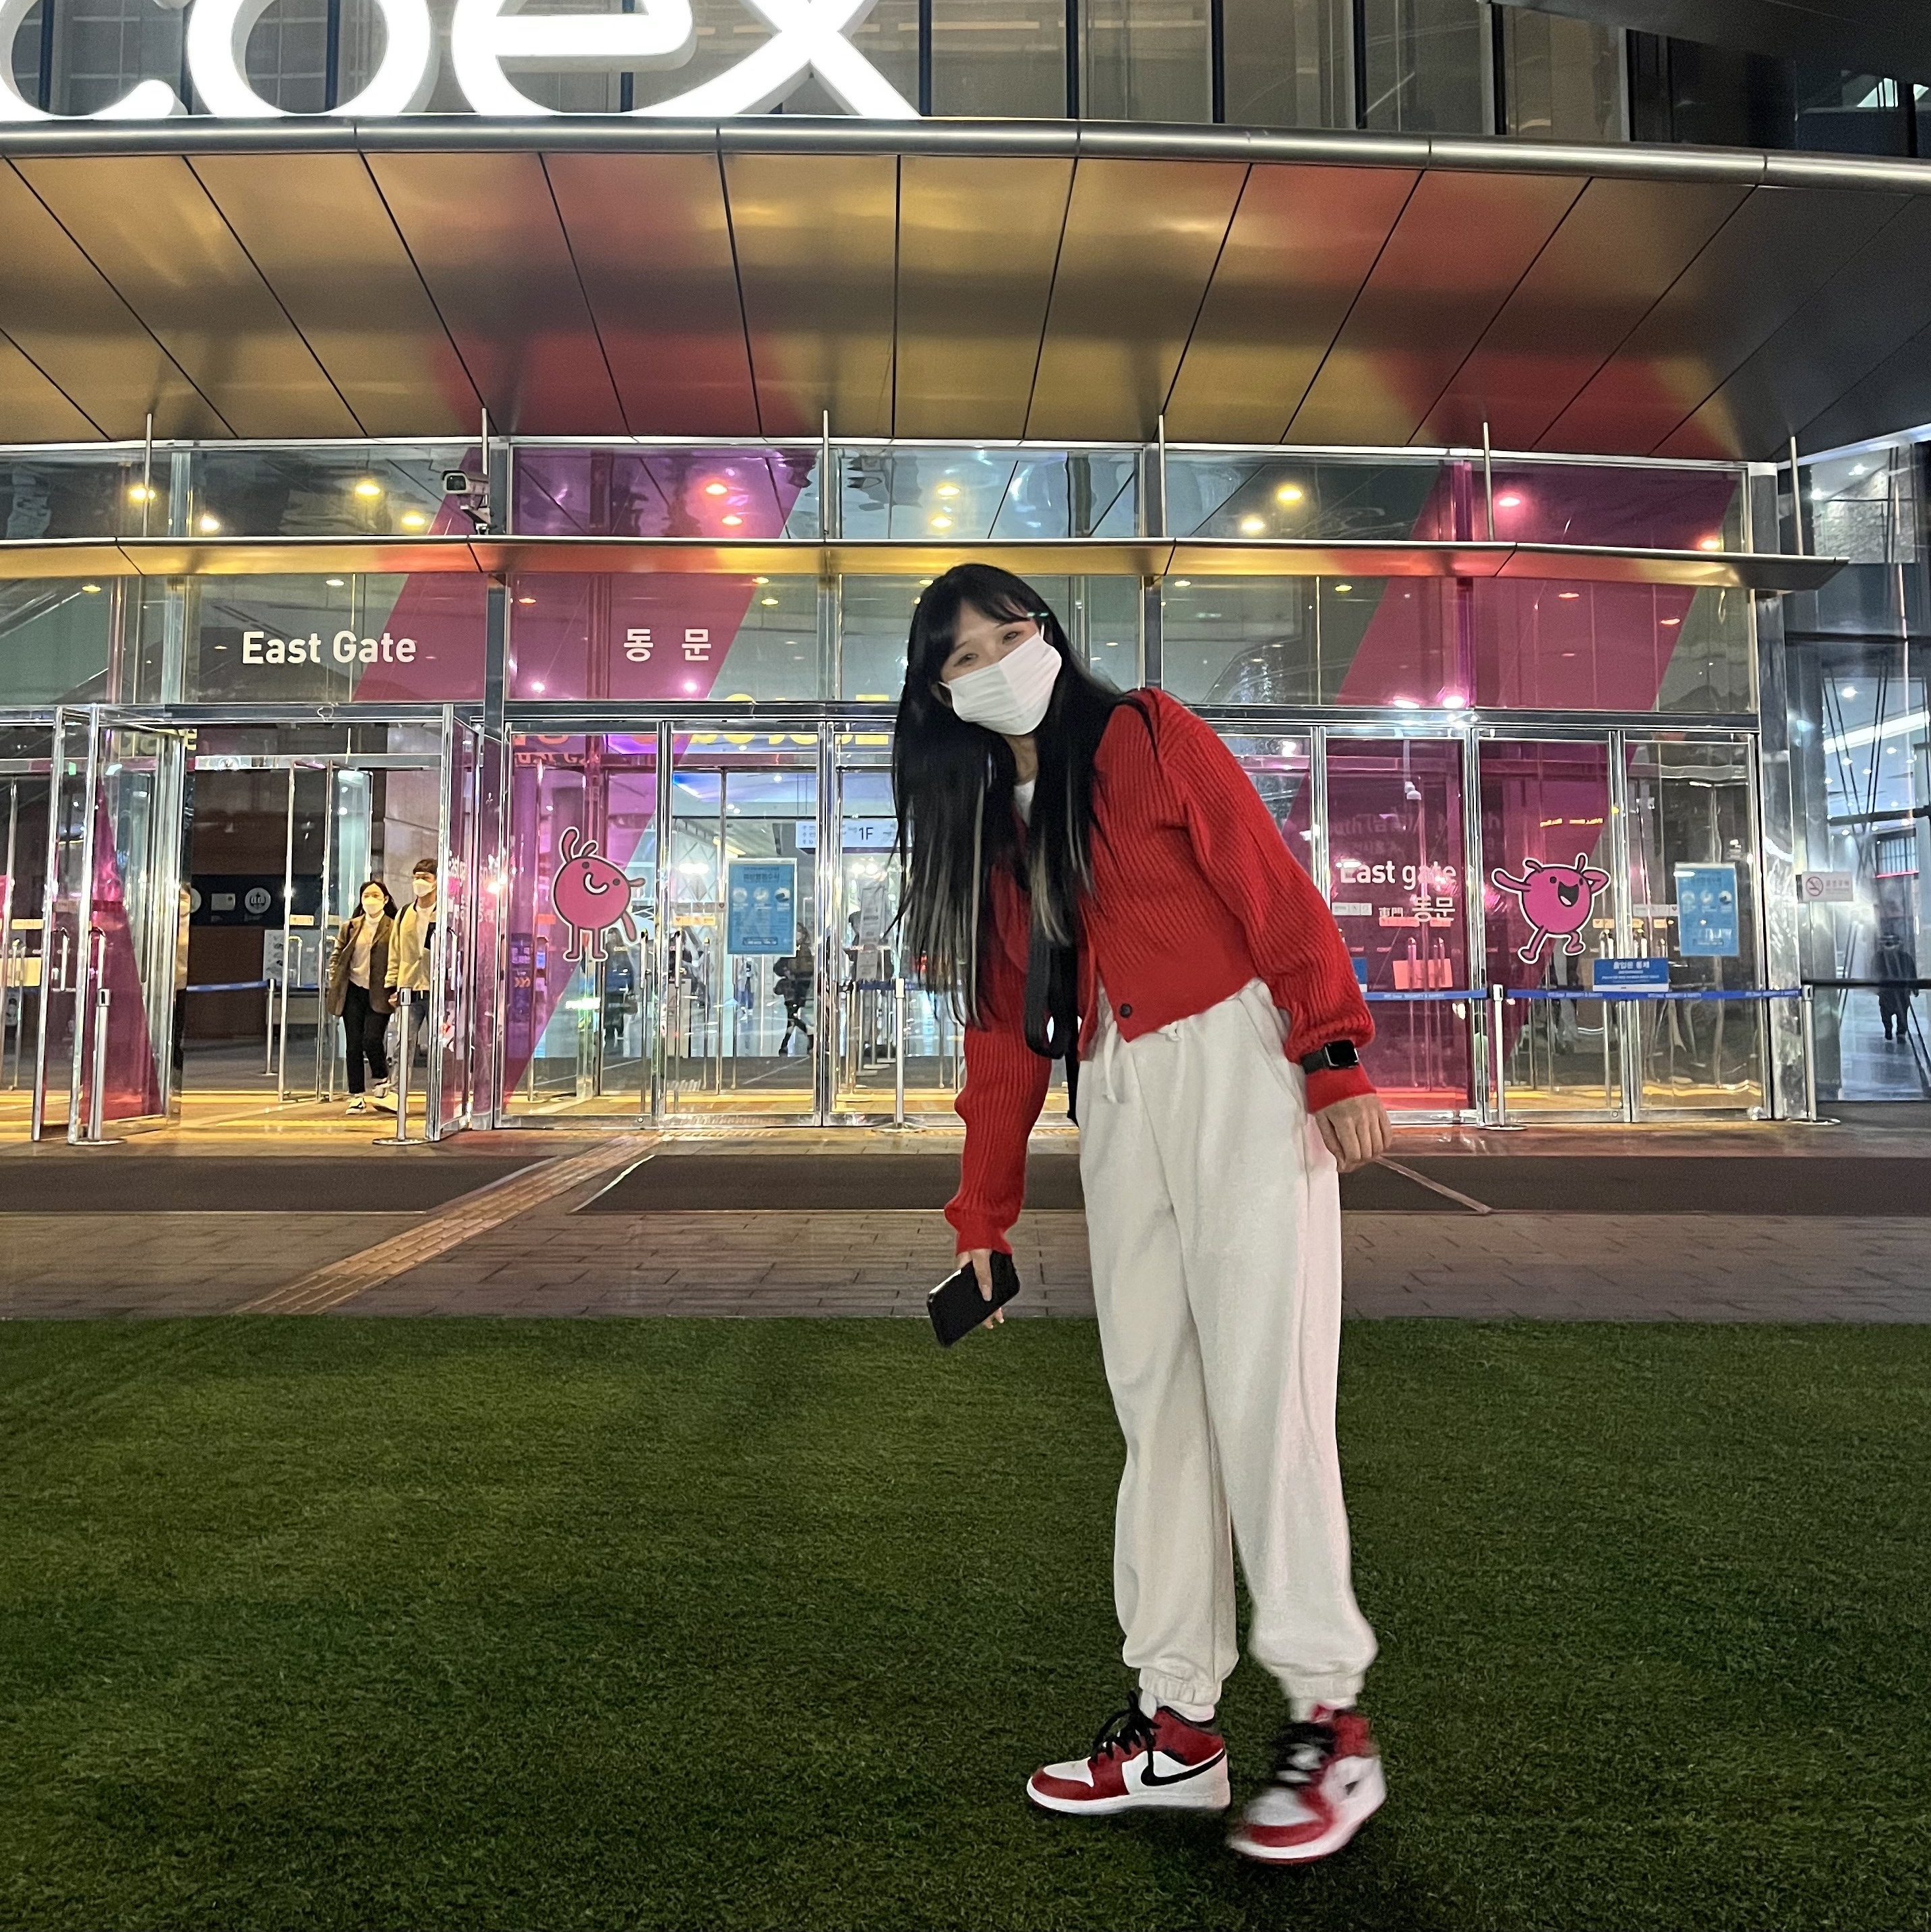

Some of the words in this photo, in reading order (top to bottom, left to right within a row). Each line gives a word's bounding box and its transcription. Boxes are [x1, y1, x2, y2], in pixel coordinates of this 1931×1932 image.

[242, 631, 321, 664] East
[332, 630, 416, 663] Gate
[858, 827, 874, 841] 1F
[1340, 858, 1396, 884] East
[1412, 896, 1456, 923] 동문
